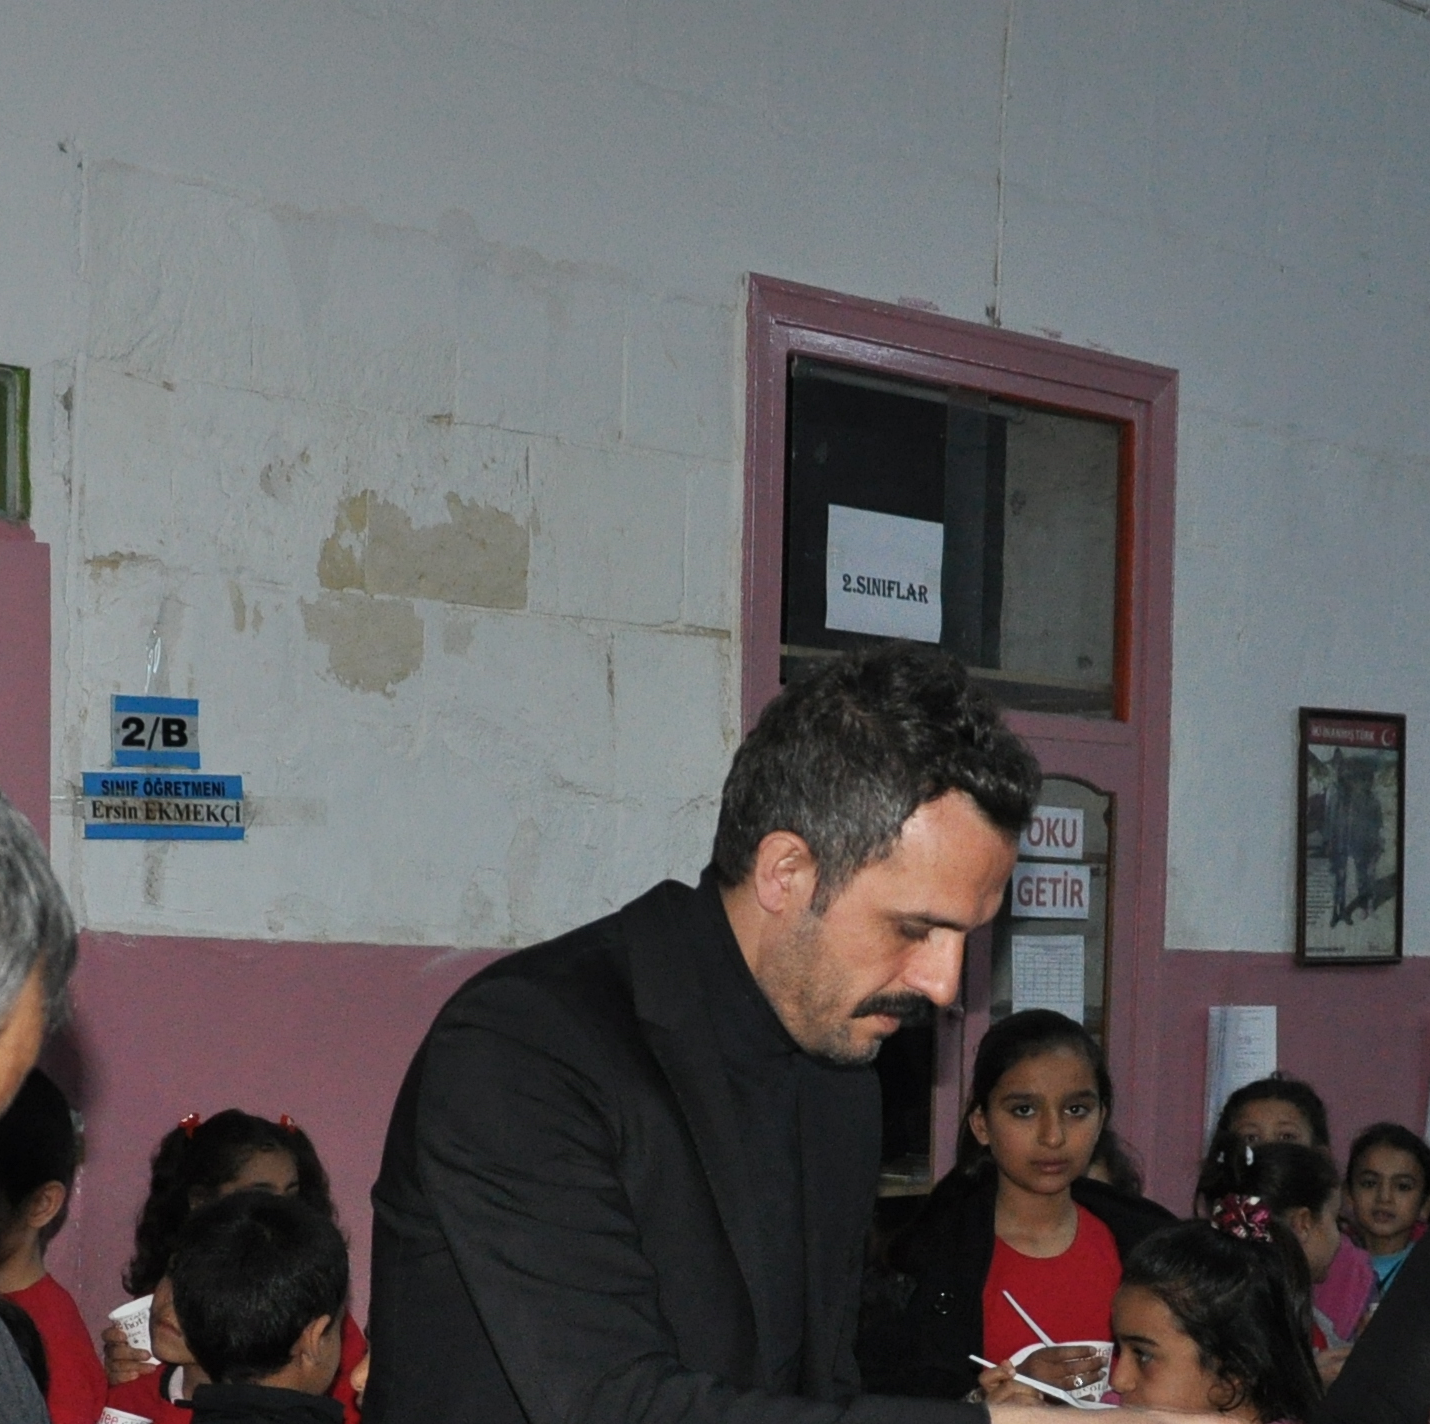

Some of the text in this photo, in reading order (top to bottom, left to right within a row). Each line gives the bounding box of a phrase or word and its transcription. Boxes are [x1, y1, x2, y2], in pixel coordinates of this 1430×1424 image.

[842, 573, 929, 604] 2.SINIFLAR
[121, 716, 189, 751] 2/B
[101, 778, 138, 796] SINIF
[92, 800, 138, 820] Ersin
[1026, 815, 1077, 848] OKU
[1017, 871, 1084, 907] GETİR
